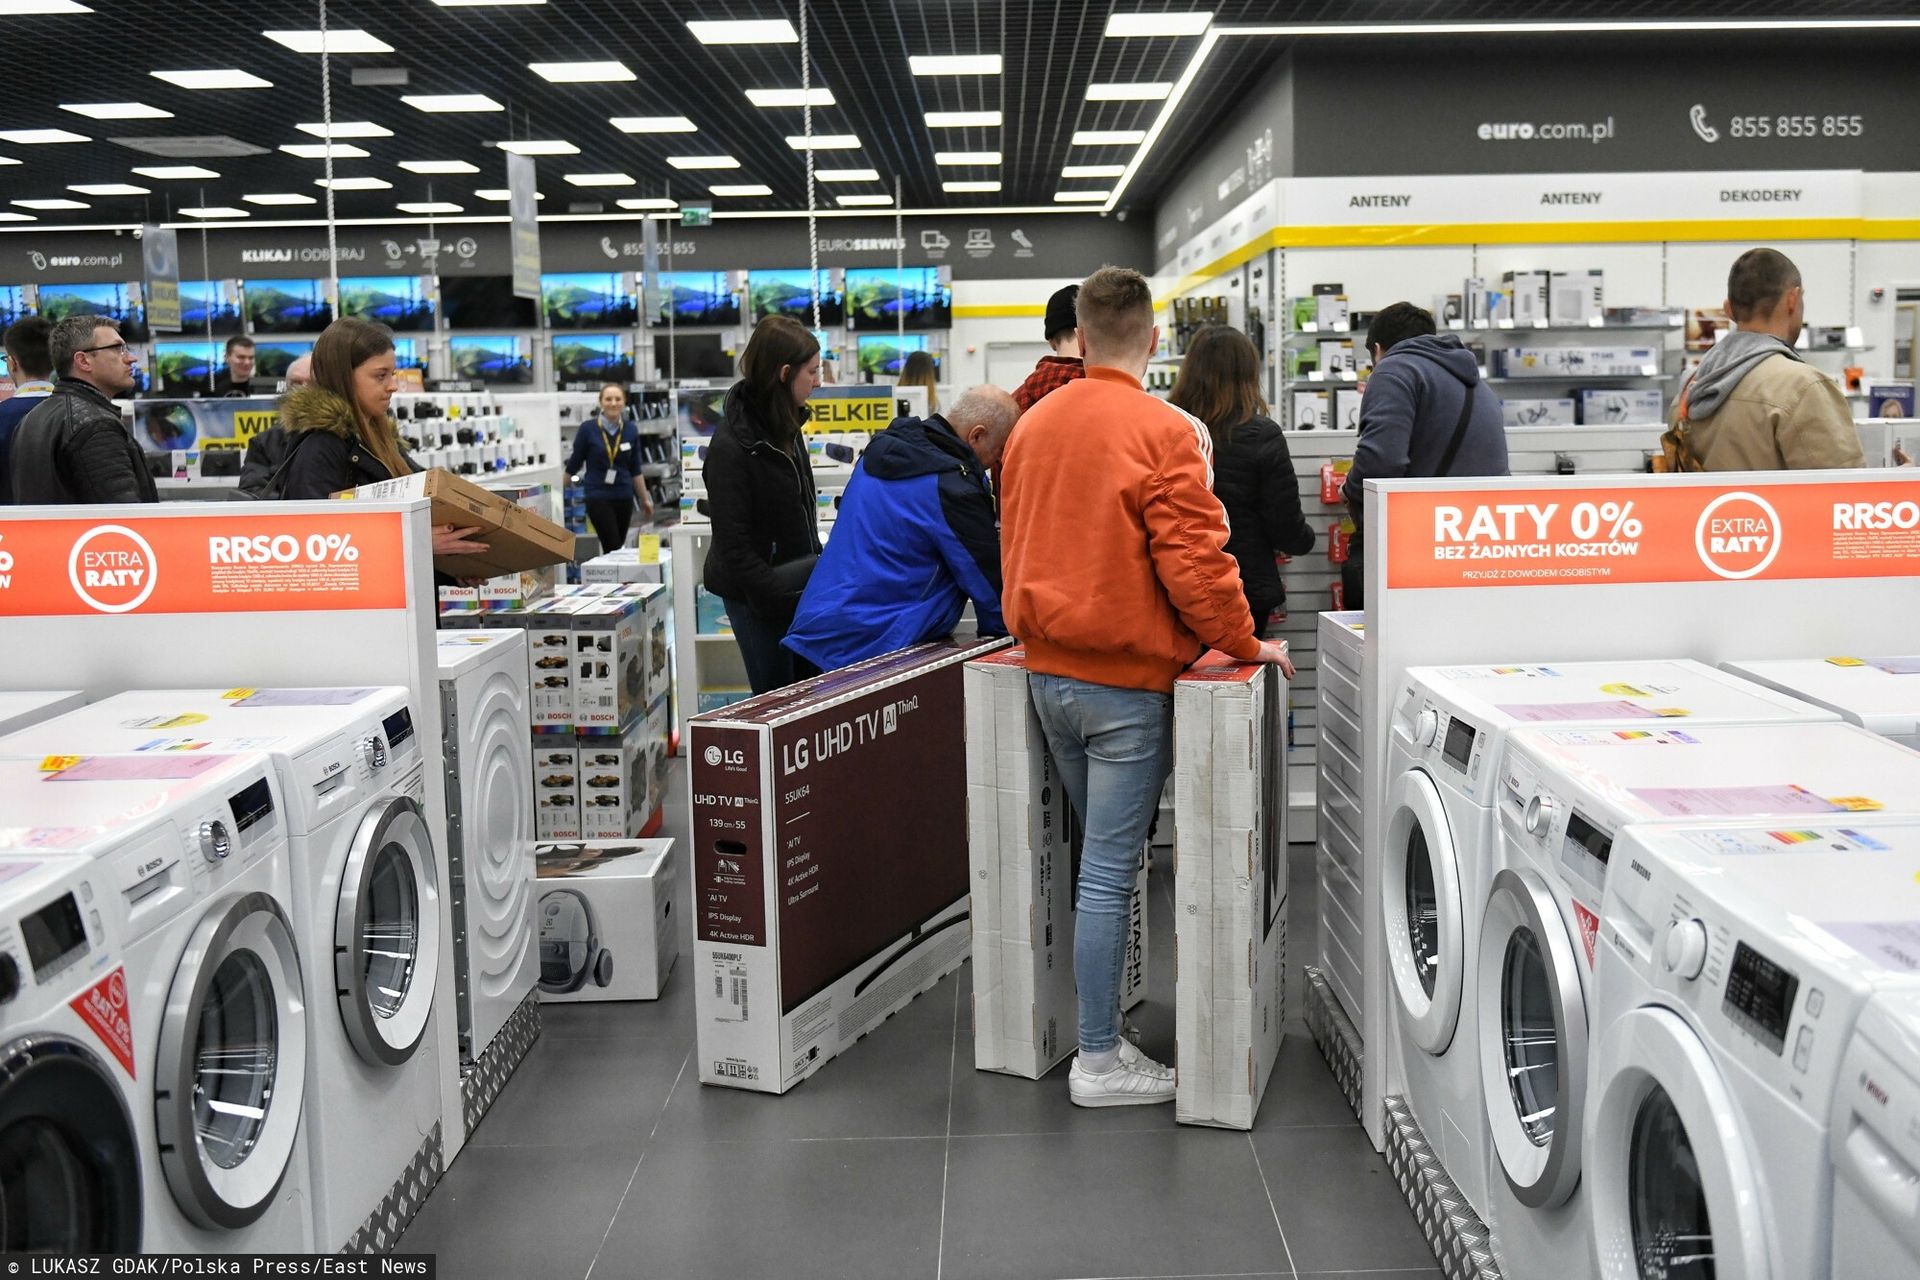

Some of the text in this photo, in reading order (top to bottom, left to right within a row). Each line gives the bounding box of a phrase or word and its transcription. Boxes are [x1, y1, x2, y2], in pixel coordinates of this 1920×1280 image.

[1477, 116, 1614, 142] euro.com.pl
[1729, 115, 1863, 138] 855 855 855
[1349, 194, 1411, 208] ANTENY
[1540, 192, 1603, 205] ANTENY
[1719, 188, 1802, 202] DEKODERY
[242, 248, 292, 263] KLIKAJ
[300, 247, 366, 262] ODBERAJ
[673, 241, 697, 255] 855
[50, 252, 123, 269] euro.com.pl
[1434, 500, 1643, 543] RATY 0%
[1832, 501, 1920, 530] RRSO
[1711, 517, 1768, 534] EXTRA
[208, 533, 360, 564] RRSO 0%
[1434, 539, 1639, 560] BEZ ŻADNYCH KOSZTÓW
[1710, 536, 1769, 554] RATY
[83, 551, 144, 568] EXTRA
[84, 569, 145, 588] RATY
[1462, 567, 1611, 579] PRZYJDŹ Z DOWODEM OSOBISTYM
[494, 587, 518, 595] BOSCH
[547, 712, 572, 720] BOSCH
[783, 737, 809, 776] LG
[815, 721, 853, 762] UHD
[855, 709, 879, 745] TV
[897, 694, 919, 716] ThinQ
[724, 749, 744, 765] LG
[328, 761, 341, 773] BOSCH
[694, 793, 717, 805] UHD
[718, 795, 733, 807] TV
[784, 783, 810, 805] 55UK64
[709, 818, 724, 829] 139
[719, 913, 742, 924] Display
[709, 930, 755, 942] 4K Active HDR
[1132, 889, 1142, 988] HITACHI
